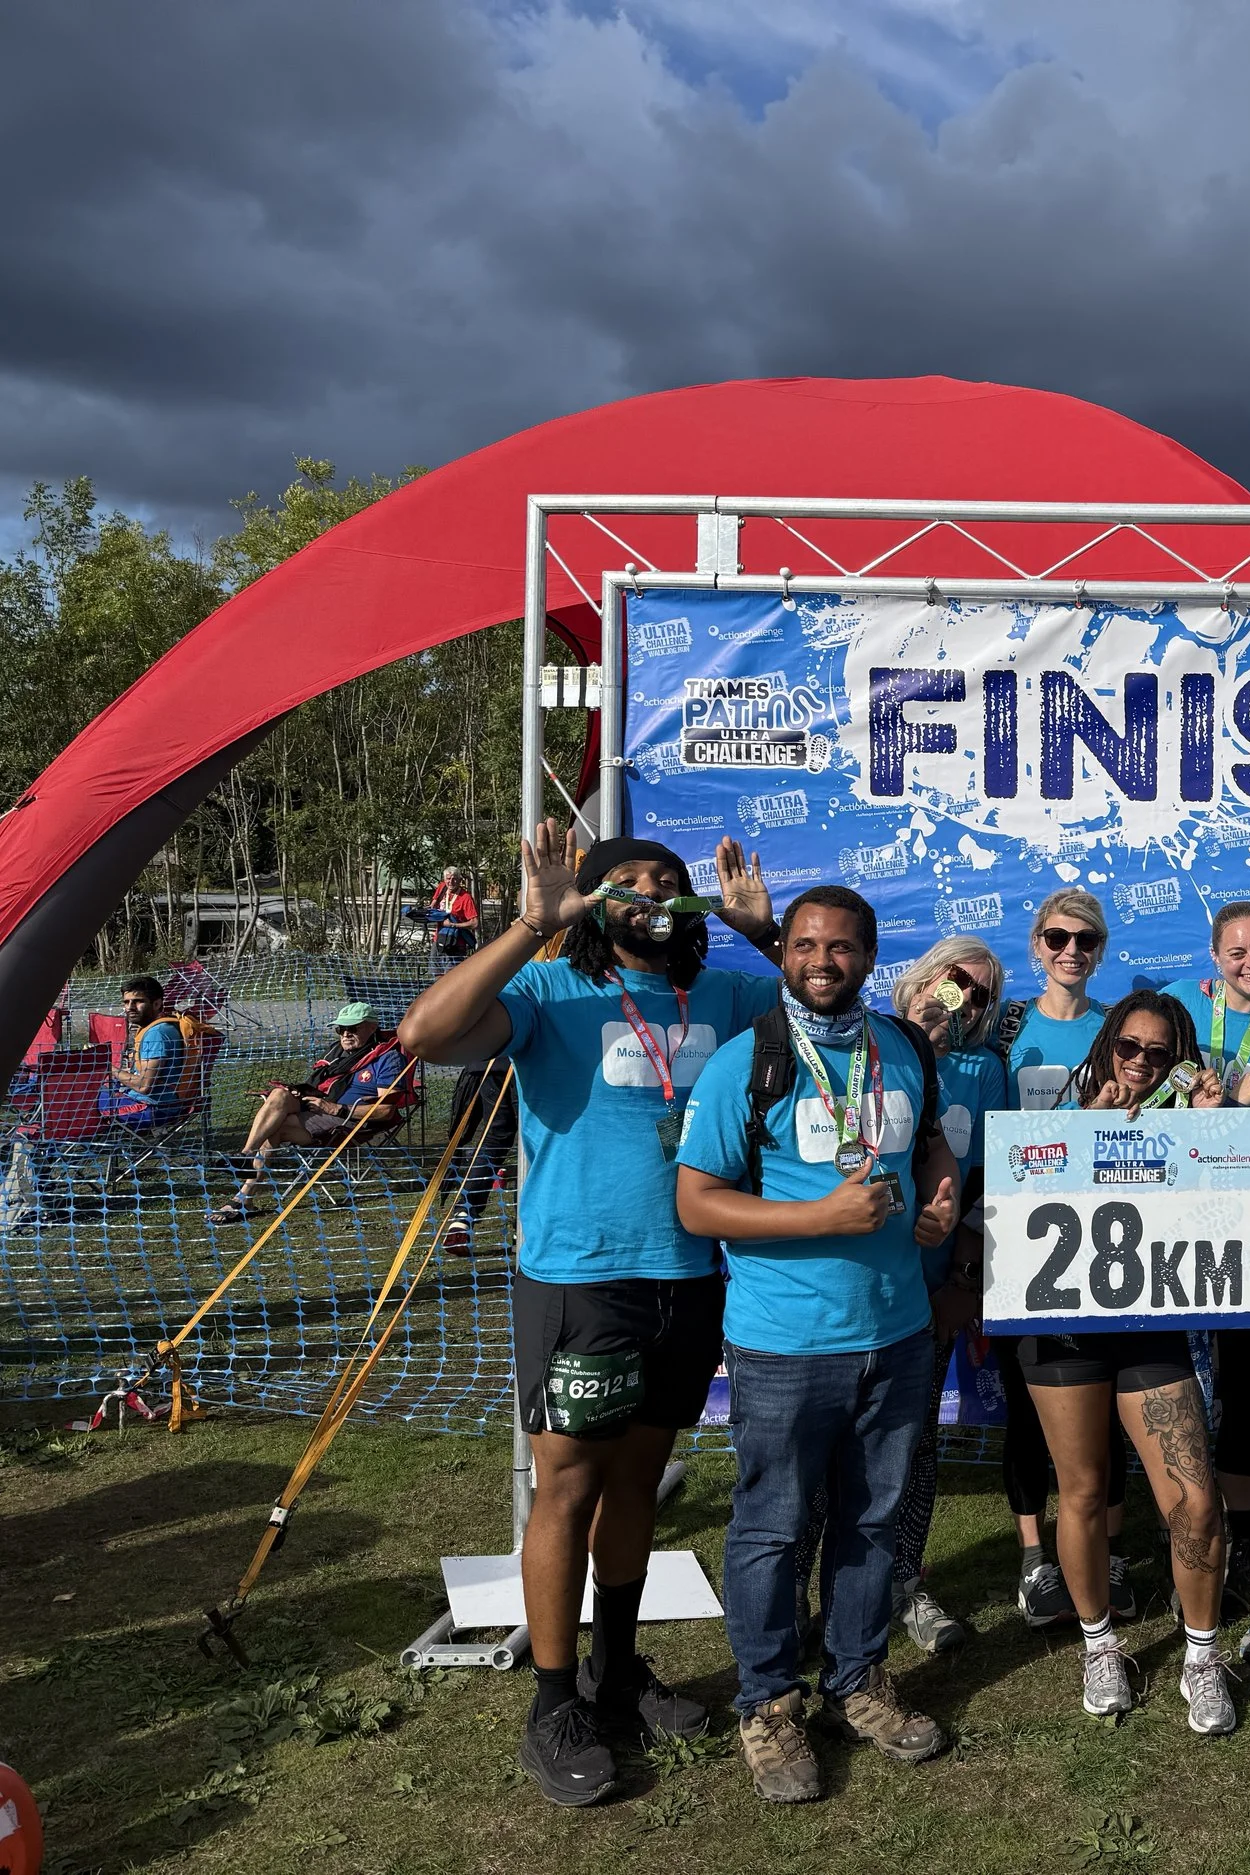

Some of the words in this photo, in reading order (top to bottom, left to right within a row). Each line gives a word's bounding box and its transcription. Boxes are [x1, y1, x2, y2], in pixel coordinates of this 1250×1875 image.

[643, 622, 687, 639] ULTRA
[719, 627, 784, 641] actionchallenge
[646, 638, 688, 650] CHALLENGE
[687, 681, 769, 699] THAMES
[643, 696, 684, 707] actioncha
[685, 699, 778, 730] PATH
[720, 730, 771, 741] ULTRA
[760, 794, 804, 811] ULTRA
[762, 806, 805, 820] CHALLENGE
[656, 815, 724, 828] actionchallenge
[863, 859, 905, 873] CHALLENGE
[691, 873, 720, 885] LLENGE
[761, 867, 822, 879] tionchallenge
[1135, 881, 1176, 899] ULTRA
[1137, 895, 1178, 909] CHALLENGE
[1129, 953, 1193, 966] actionchallenge
[872, 964, 906, 982] ULTR
[617, 1047, 648, 1058] Mosa
[799, 1041, 827, 1082] CHALLENGE
[851, 1063, 861, 1099] QUARTER
[1027, 1086, 1060, 1096] Mosaic
[943, 1125, 968, 1135] house
[1094, 1130, 1144, 1141] THAMES
[1027, 1147, 1064, 1160] ULTRA
[1094, 1142, 1147, 1160] PATH
[1028, 1159, 1065, 1168] CHALLENGE
[1100, 1169, 1160, 1182] CHALLENGE
[569, 1375, 624, 1399] 6212
